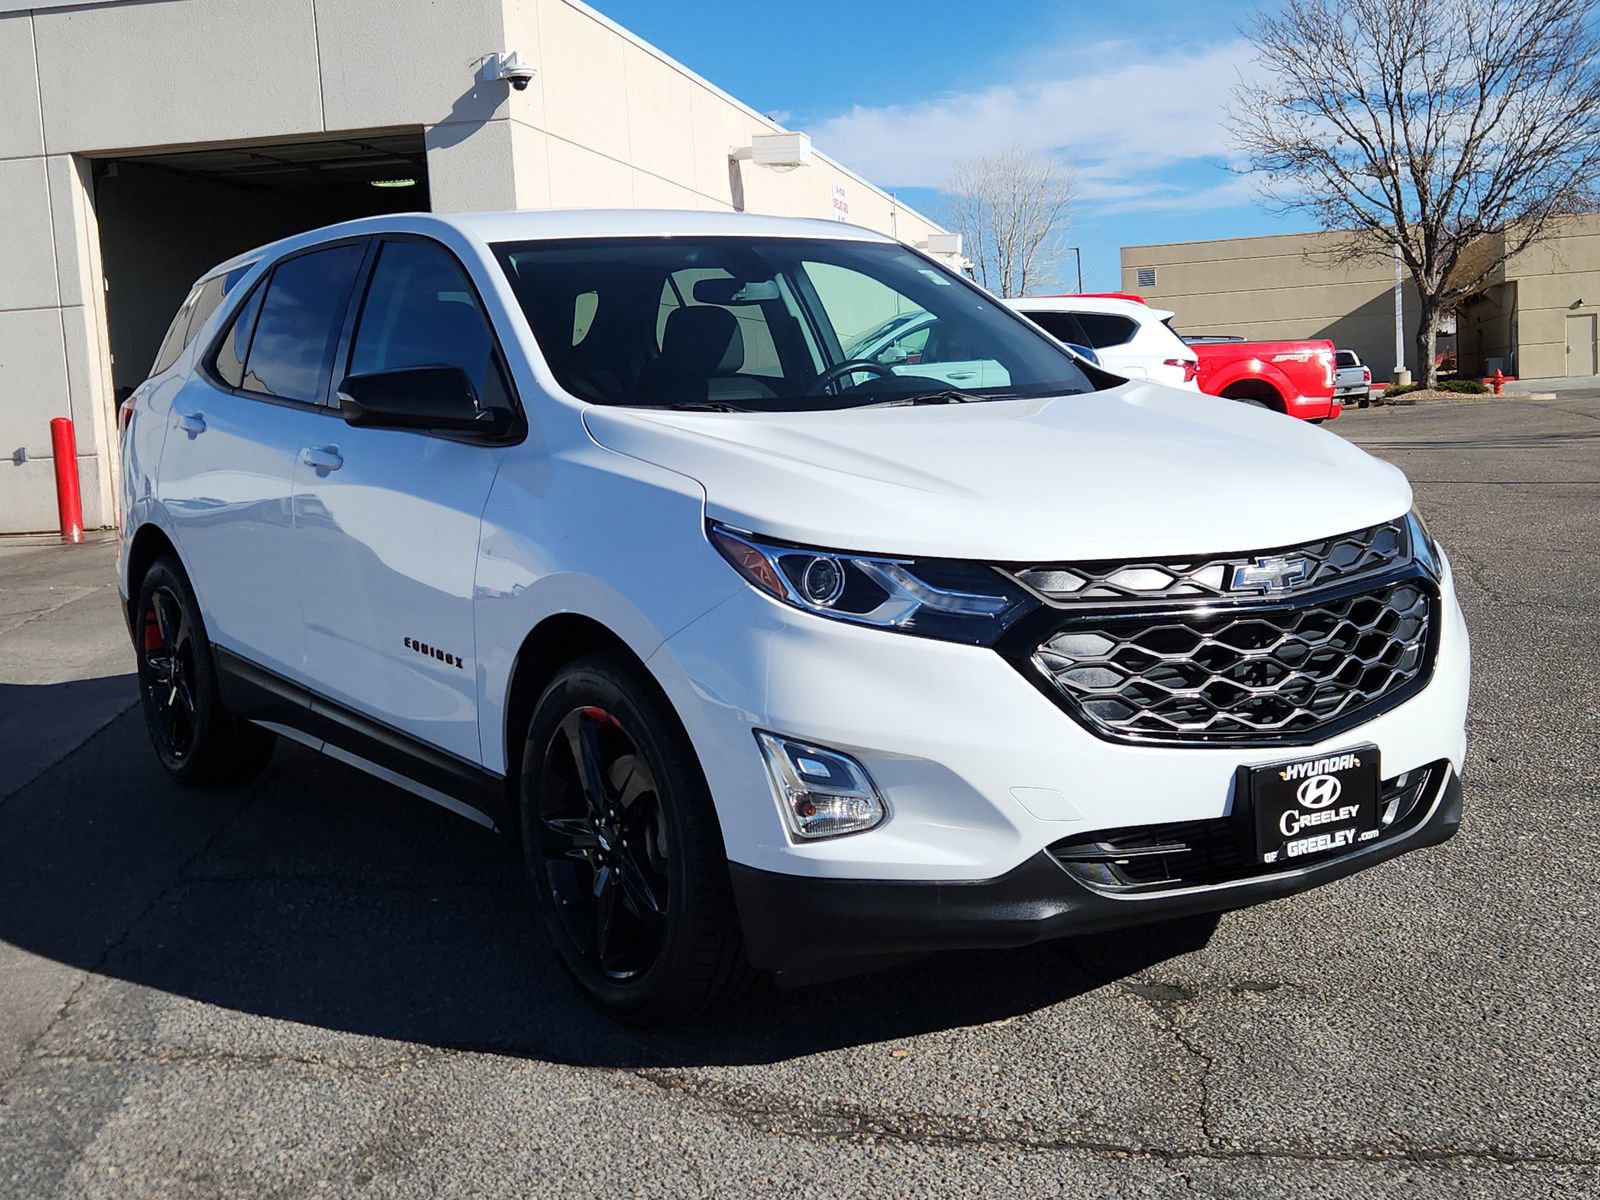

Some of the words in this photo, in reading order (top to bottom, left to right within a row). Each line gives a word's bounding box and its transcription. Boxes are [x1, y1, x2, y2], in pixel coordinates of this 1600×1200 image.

[404, 637, 463, 669] EQUINOX
[1286, 754, 1355, 780] HYUNDAI
[1279, 804, 1360, 836] GREELEY
[1263, 850, 1279, 863] OF
[1287, 828, 1356, 857] GREELEY
